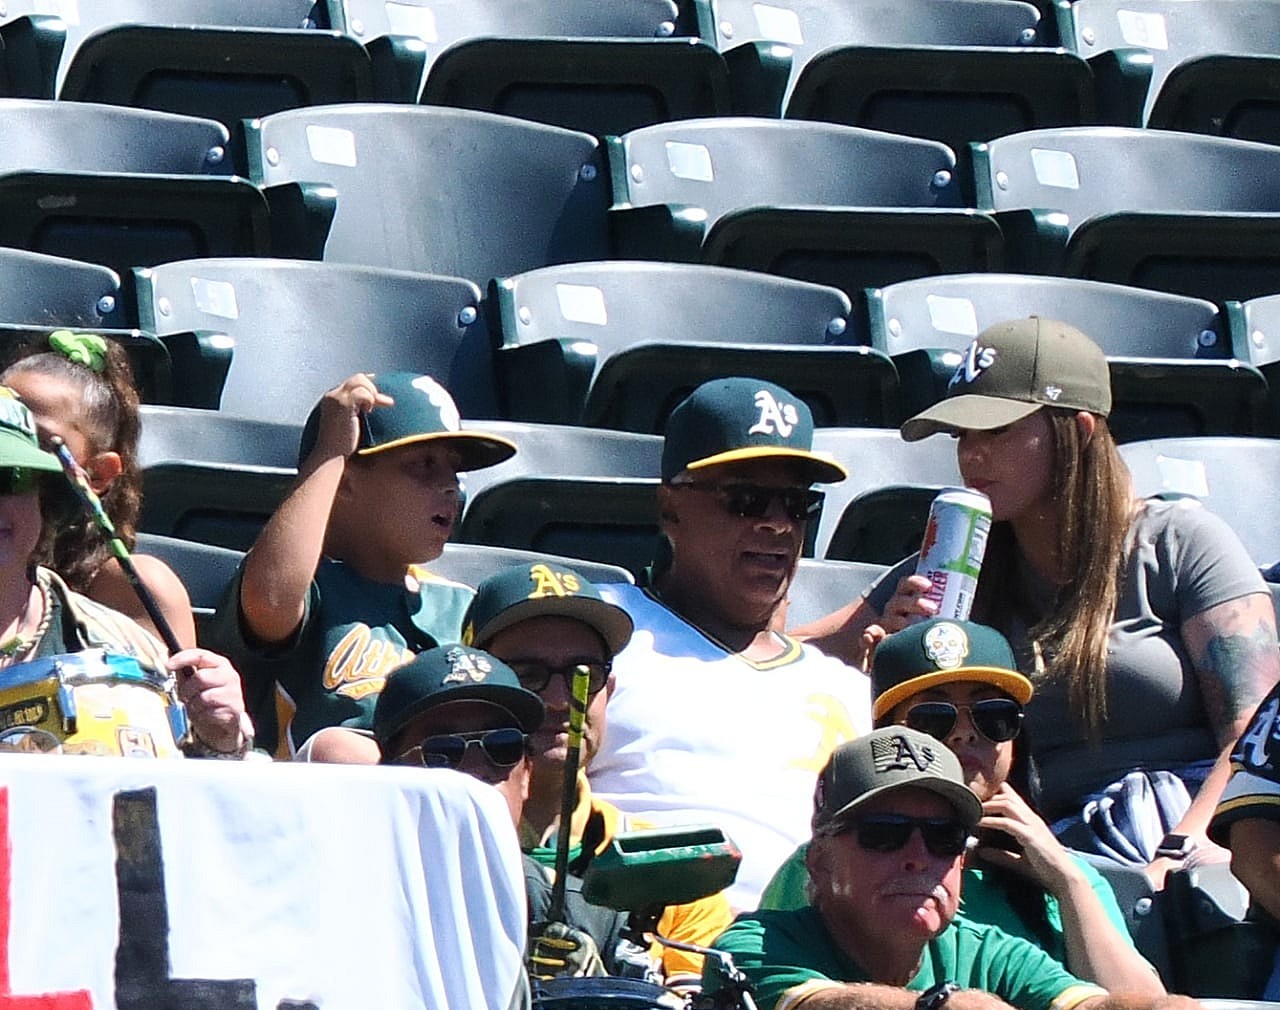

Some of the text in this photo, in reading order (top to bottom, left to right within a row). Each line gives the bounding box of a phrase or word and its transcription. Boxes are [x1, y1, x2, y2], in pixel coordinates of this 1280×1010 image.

[947, 340, 997, 391] A's
[748, 389, 799, 438] A's
[527, 564, 580, 599] A's
[885, 735, 936, 772] A's
